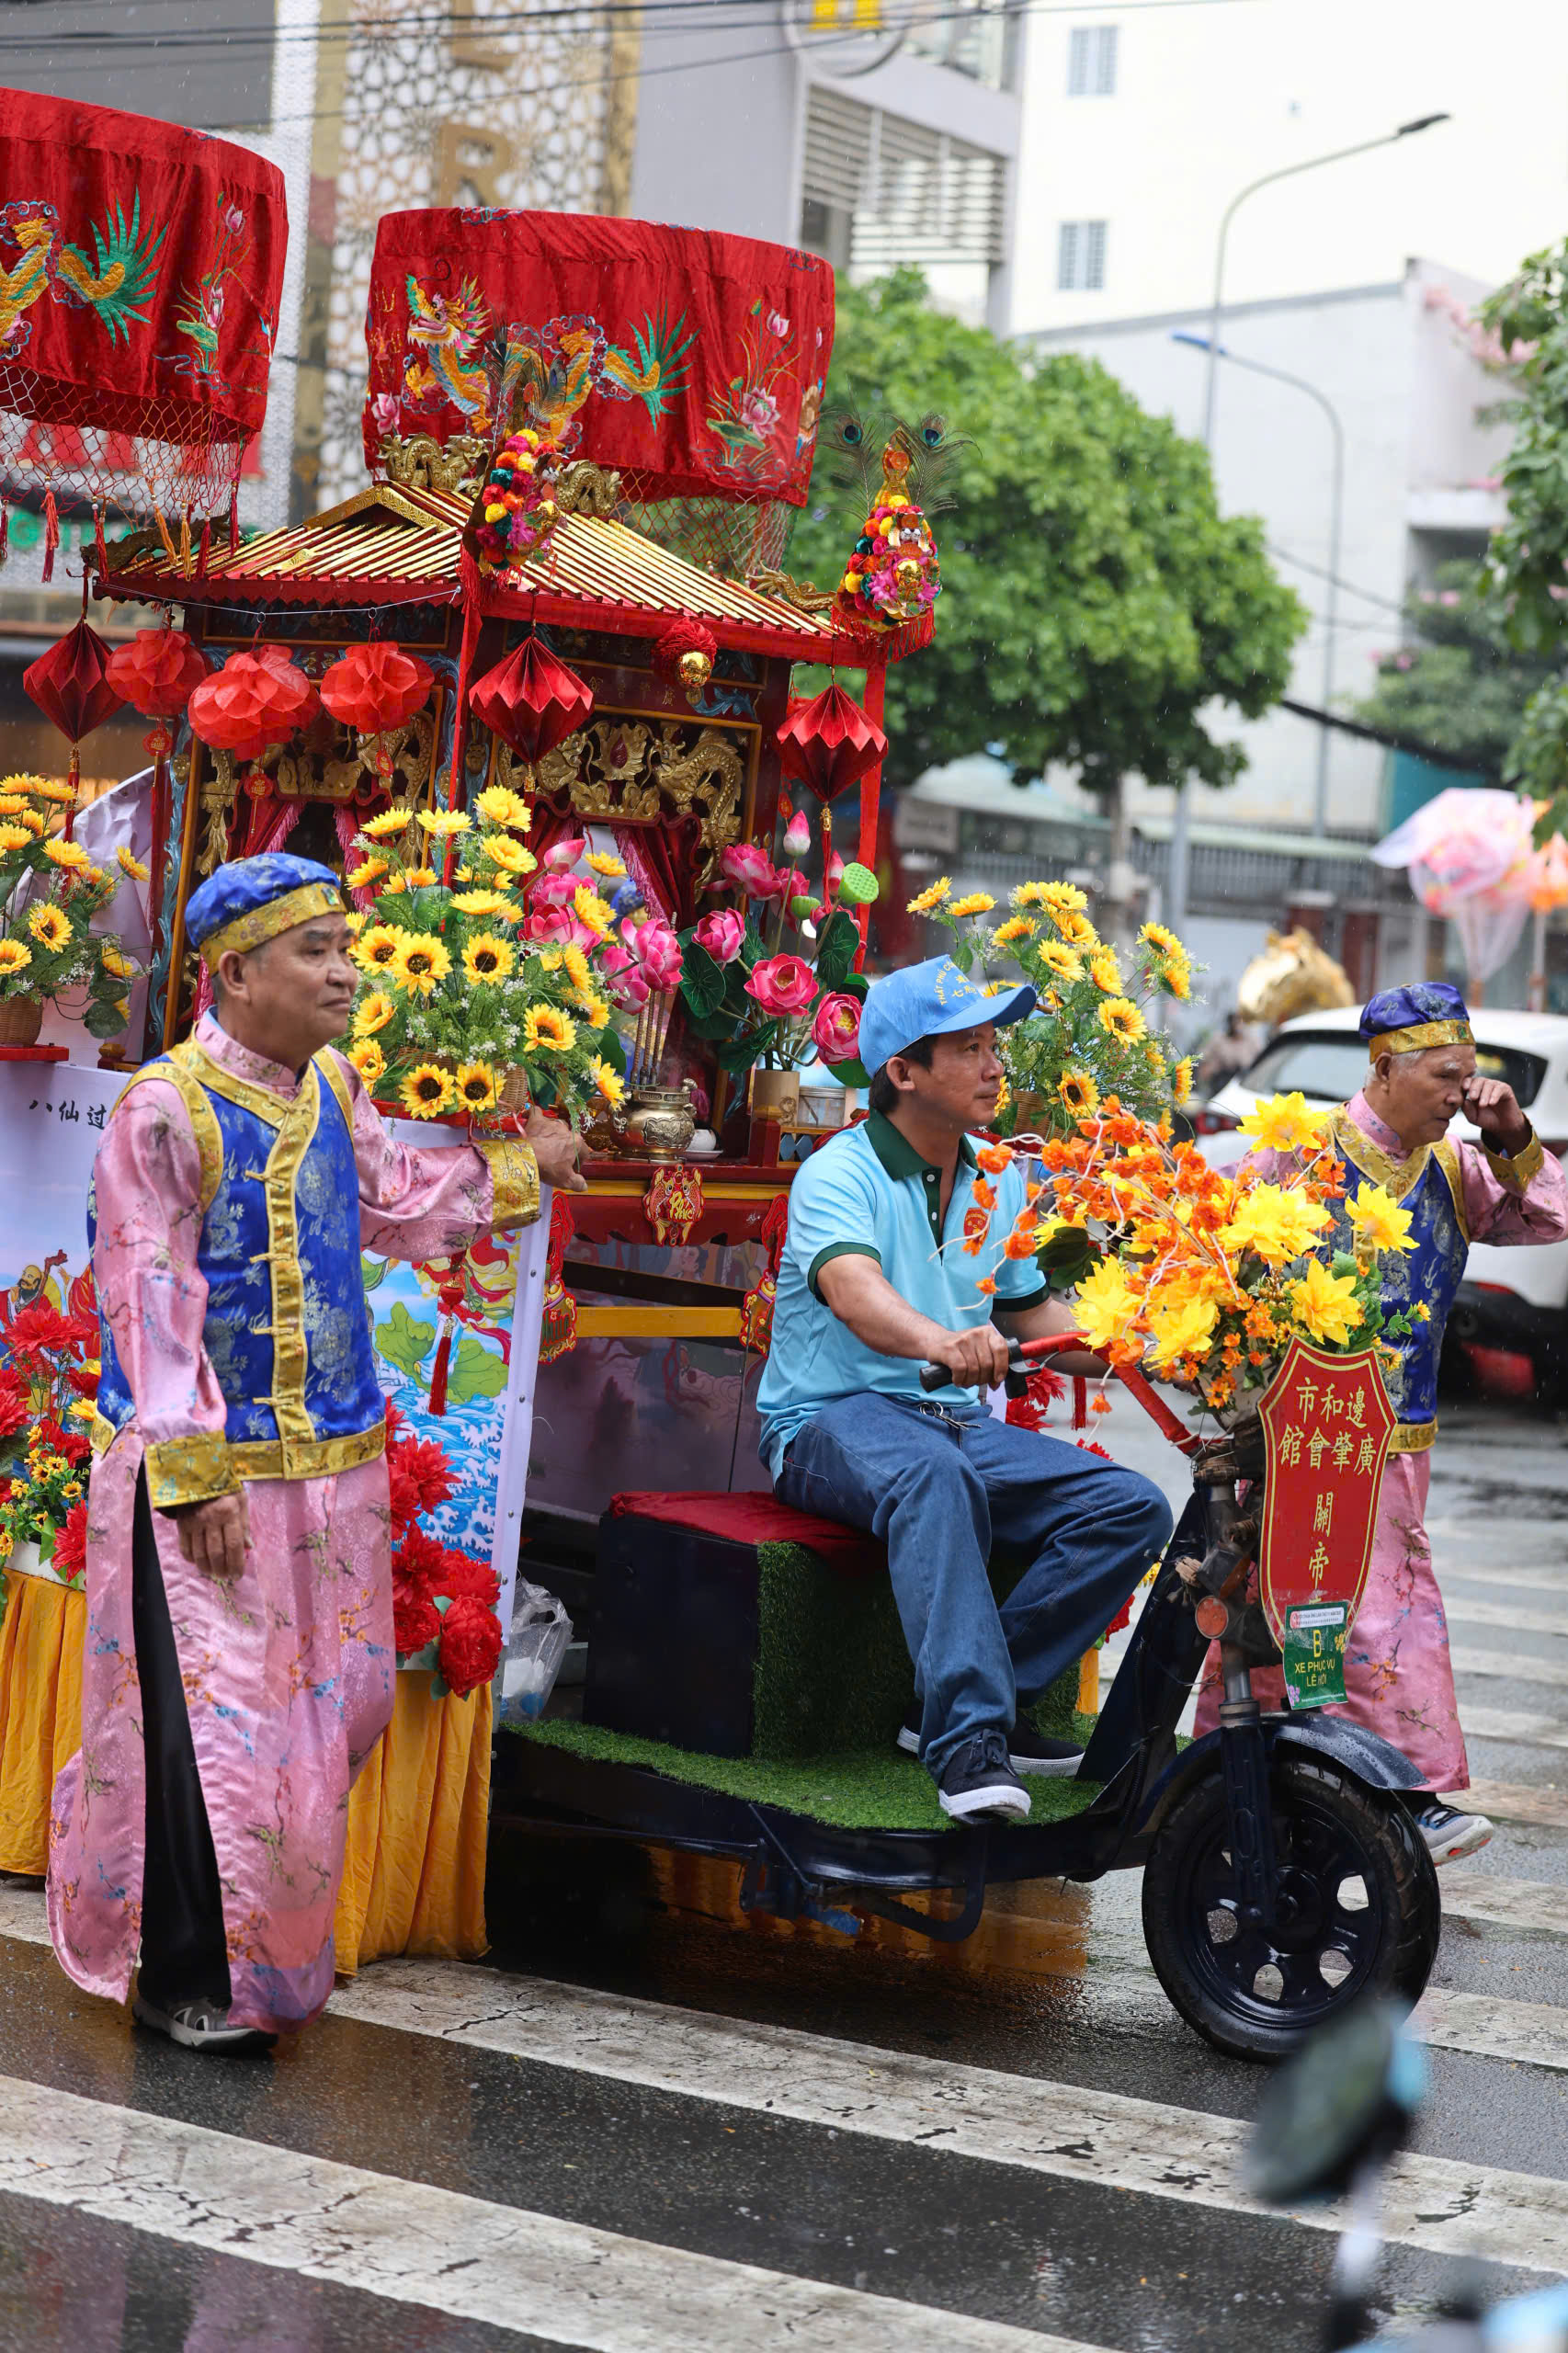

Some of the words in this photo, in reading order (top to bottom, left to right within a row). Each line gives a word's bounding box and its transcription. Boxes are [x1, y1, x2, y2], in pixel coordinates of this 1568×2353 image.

[1308, 1491, 1334, 1605] 關帝
[1312, 1629, 1322, 1658] B
[1294, 1662, 1306, 1674] XE
